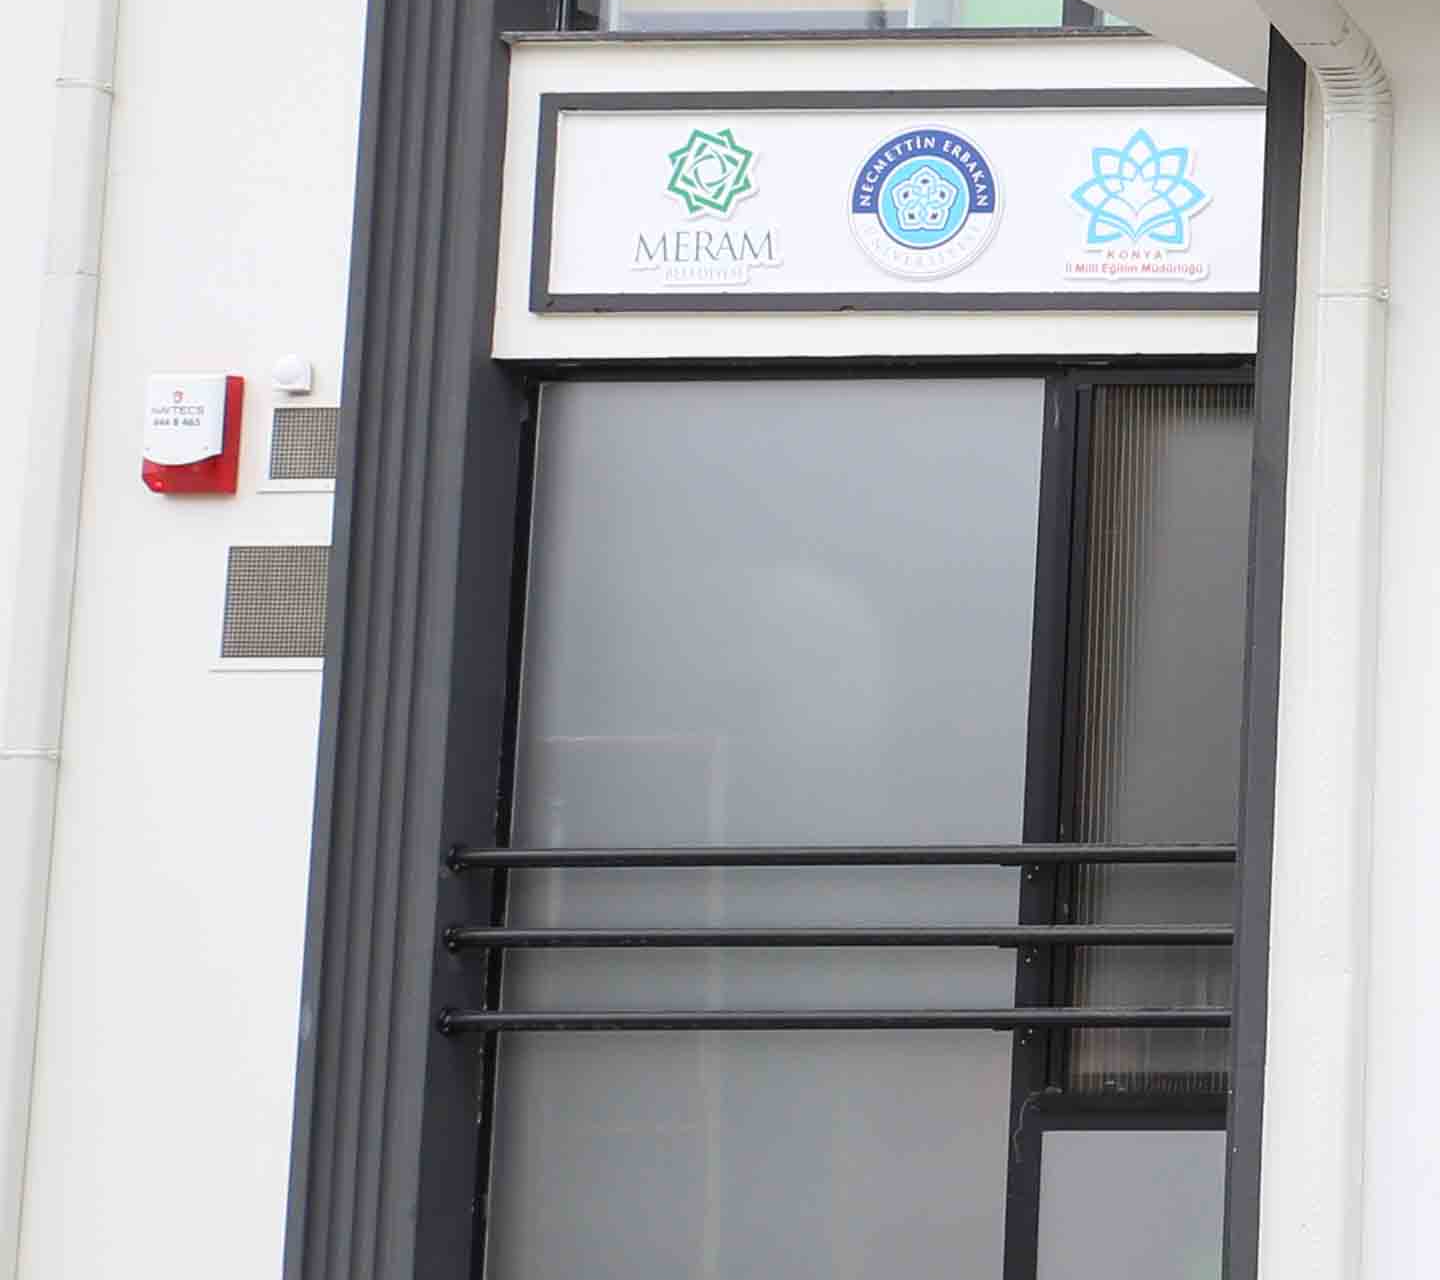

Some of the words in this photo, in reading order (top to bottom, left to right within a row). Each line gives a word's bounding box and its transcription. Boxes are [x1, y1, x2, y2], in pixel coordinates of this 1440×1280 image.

[859, 135, 936, 208] NECMETTİN
[942, 139, 990, 208] ERBAKAN
[634, 230, 774, 263] MERAM
[1105, 249, 1163, 260] KONYA
